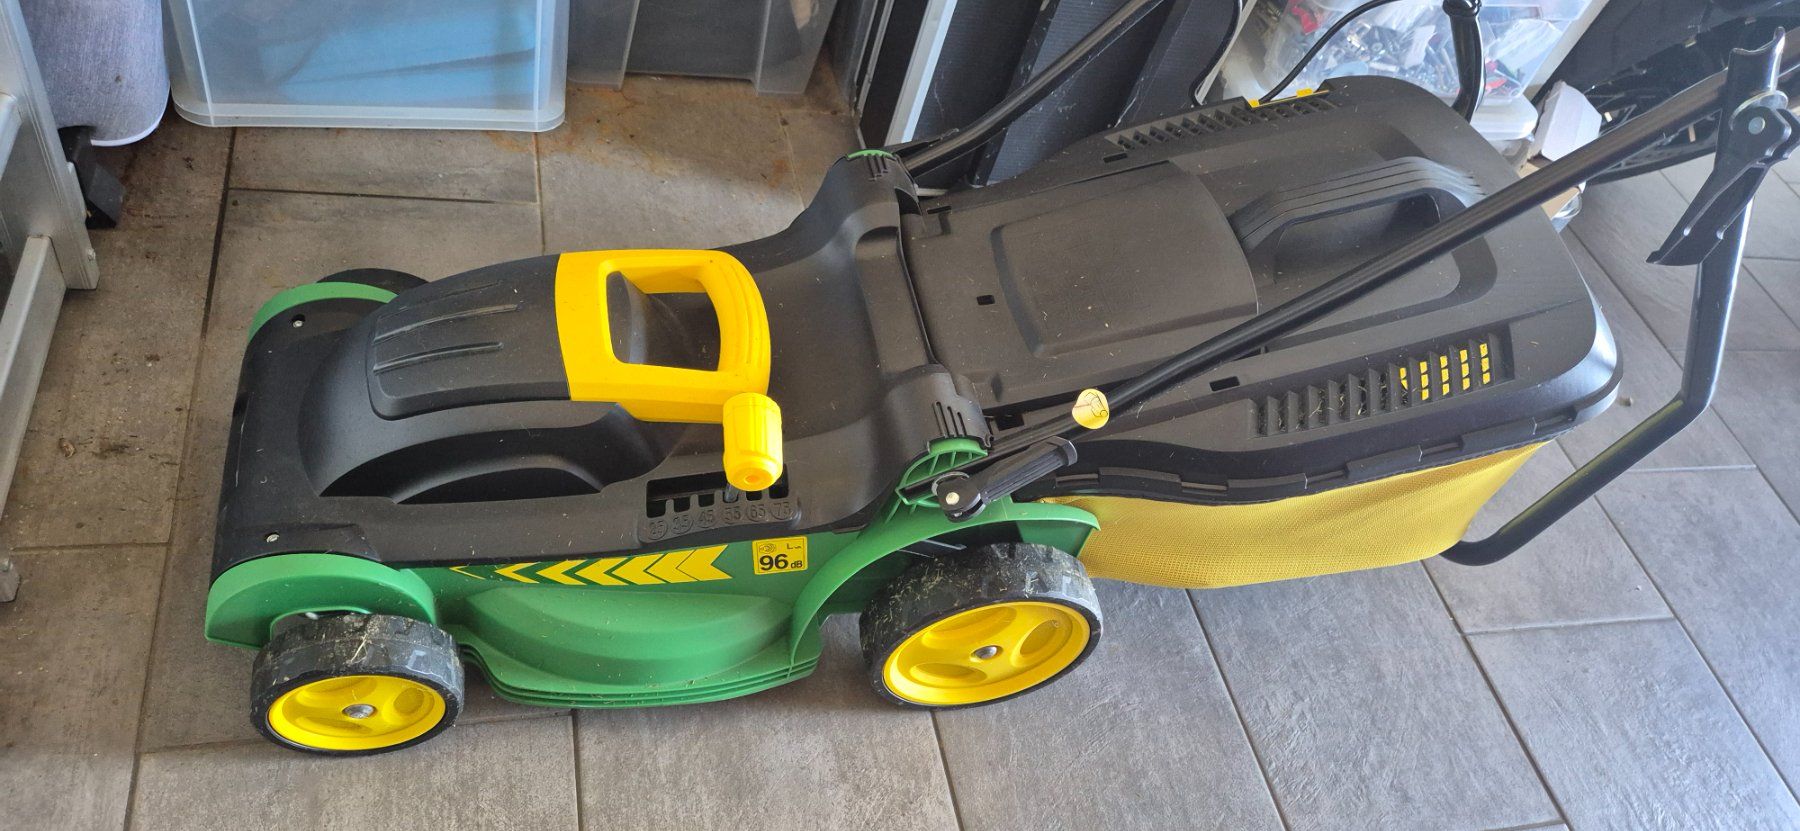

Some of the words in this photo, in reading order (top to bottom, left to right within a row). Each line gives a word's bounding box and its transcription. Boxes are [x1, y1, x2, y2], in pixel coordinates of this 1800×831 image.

[673, 514, 689, 530] 35
[699, 508, 714, 524] 45
[724, 505, 741, 521] 55
[750, 503, 766, 518] 65
[773, 501, 791, 517] 75
[759, 553, 789, 571] 96
[790, 560, 803, 569] dB
